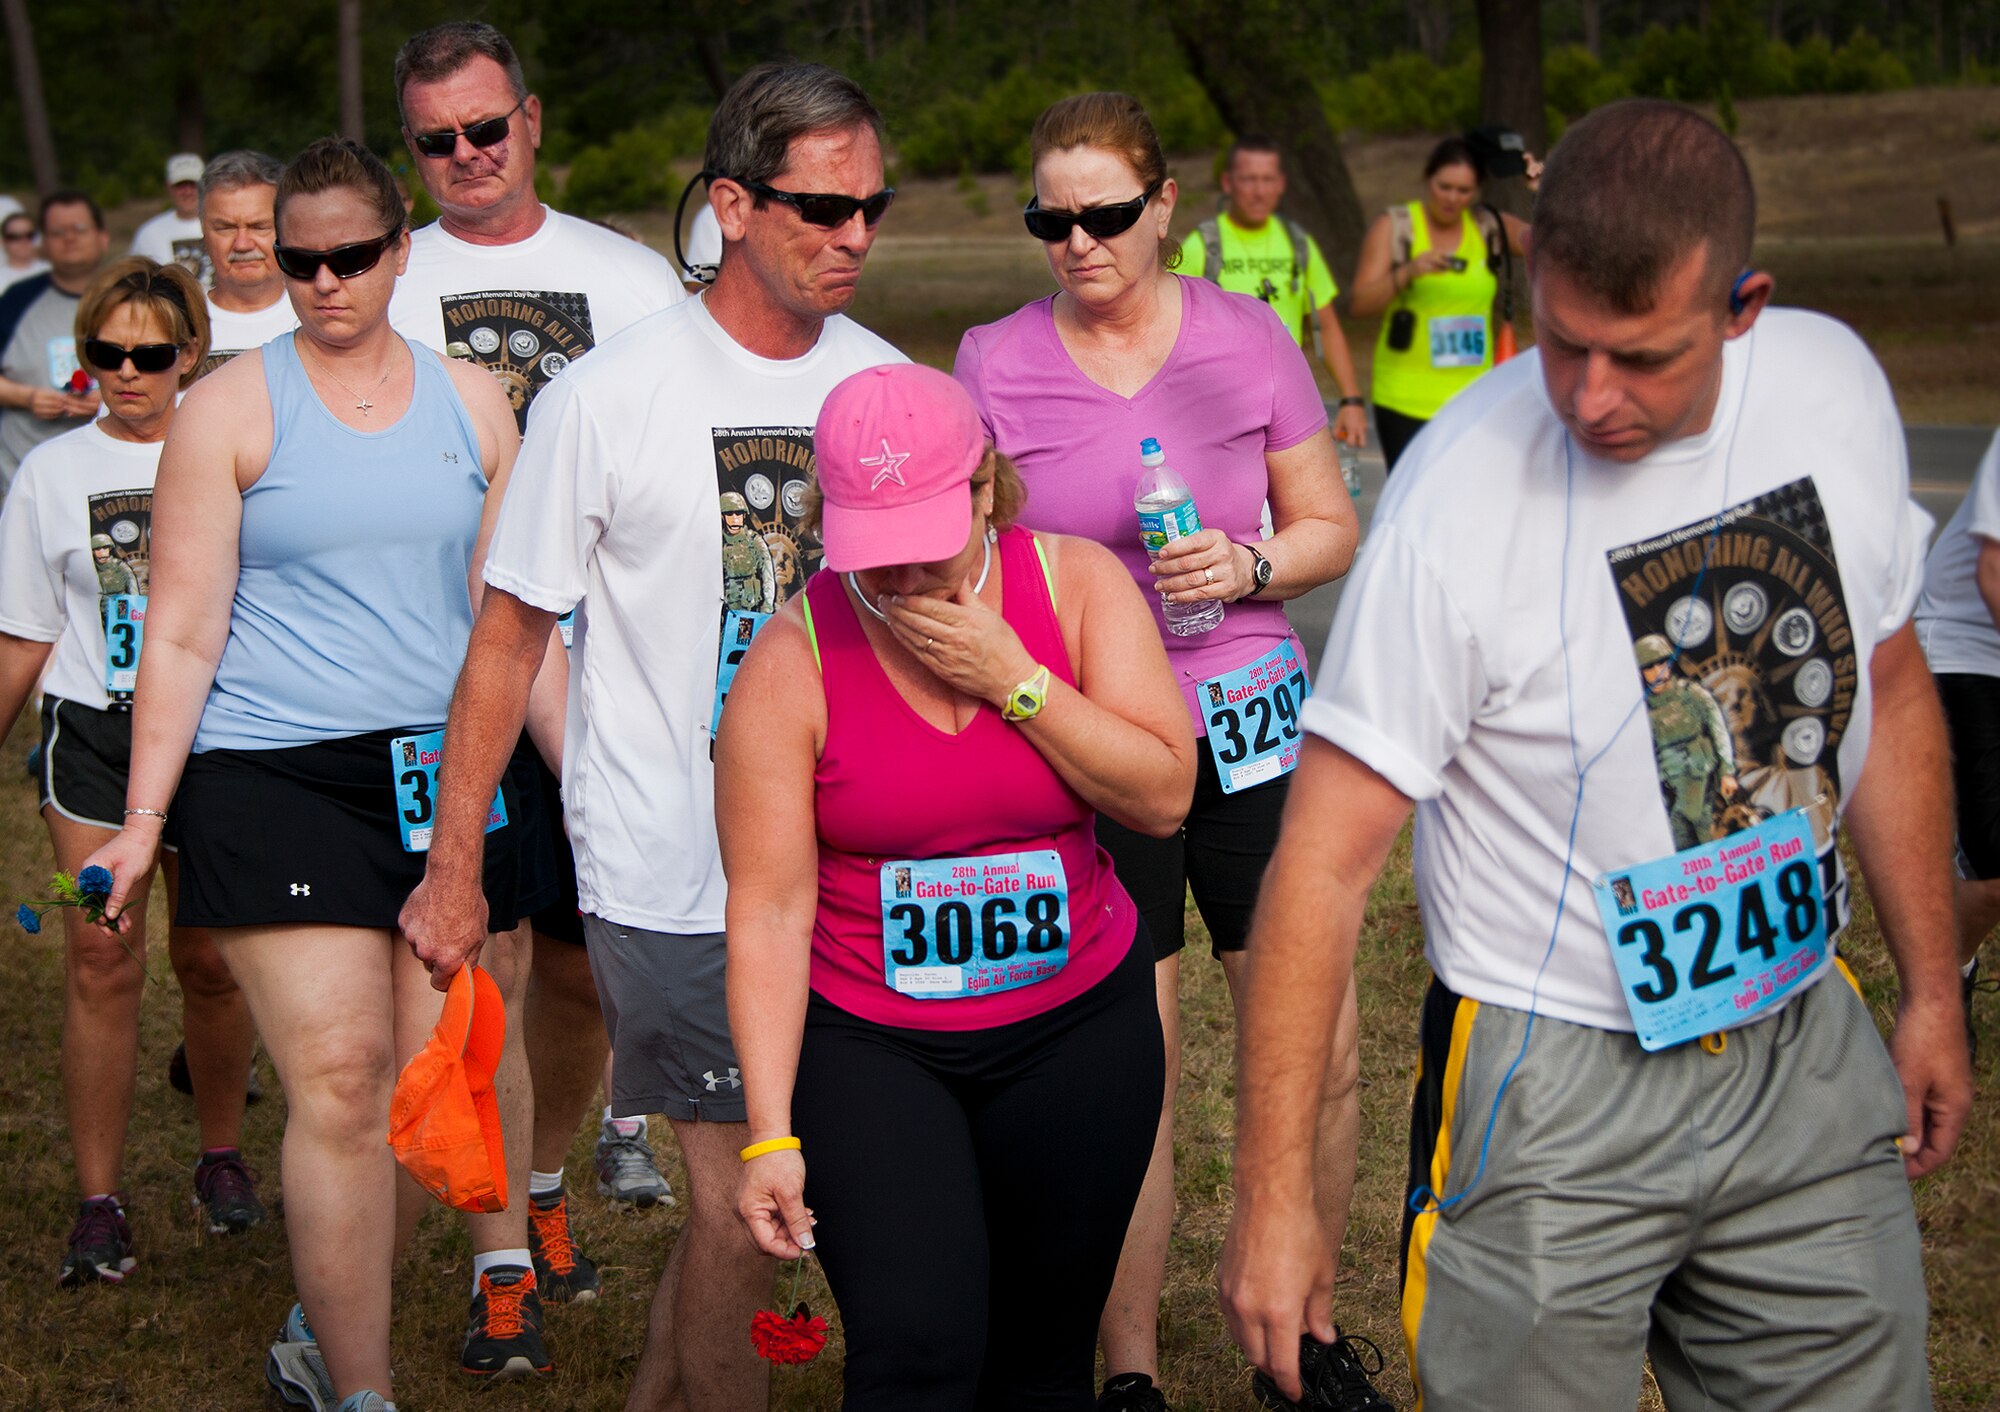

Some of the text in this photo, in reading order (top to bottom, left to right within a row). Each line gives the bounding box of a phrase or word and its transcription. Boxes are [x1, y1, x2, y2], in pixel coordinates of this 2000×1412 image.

[458, 293, 480, 301] Annual
[482, 291, 513, 299] Memorial
[513, 291, 526, 299] Day
[446, 299, 546, 328] HONORING
[543, 320, 574, 347] ALL
[713, 429, 730, 437] 28th
[731, 428, 756, 437] Annual
[757, 428, 787, 436] Memorial
[788, 428, 802, 438] Day
[104, 491, 124, 499] Annual
[1610, 546, 1635, 563] 28th
[1636, 534, 1672, 555] Annual
[1672, 517, 1718, 544] Memorial
[1620, 533, 1771, 609] HONORING
[1769, 545, 1811, 597] ALL
[1804, 577, 1851, 653] WHO
[1226, 657, 1299, 704] Gate-to-Gate Run
[1249, 654, 1282, 680] 28th Annual
[1210, 670, 1306, 765] 3297
[952, 862, 1020, 879] 28th Annual
[1642, 854, 1766, 911] Gate-to-Gate
[1769, 836, 1803, 866] Run
[1680, 836, 1762, 876] 28th Annual
[916, 876, 1020, 899] Gate-to-Gate
[1026, 873, 1056, 890] Run
[889, 892, 1063, 966] 3068
[1617, 860, 1818, 1004] 3248
[968, 965, 1057, 991] Eglin Air Force Base
[1733, 990, 1759, 1009] Eglin
[1762, 981, 1774, 996] Air
[1776, 966, 1798, 987] Force
